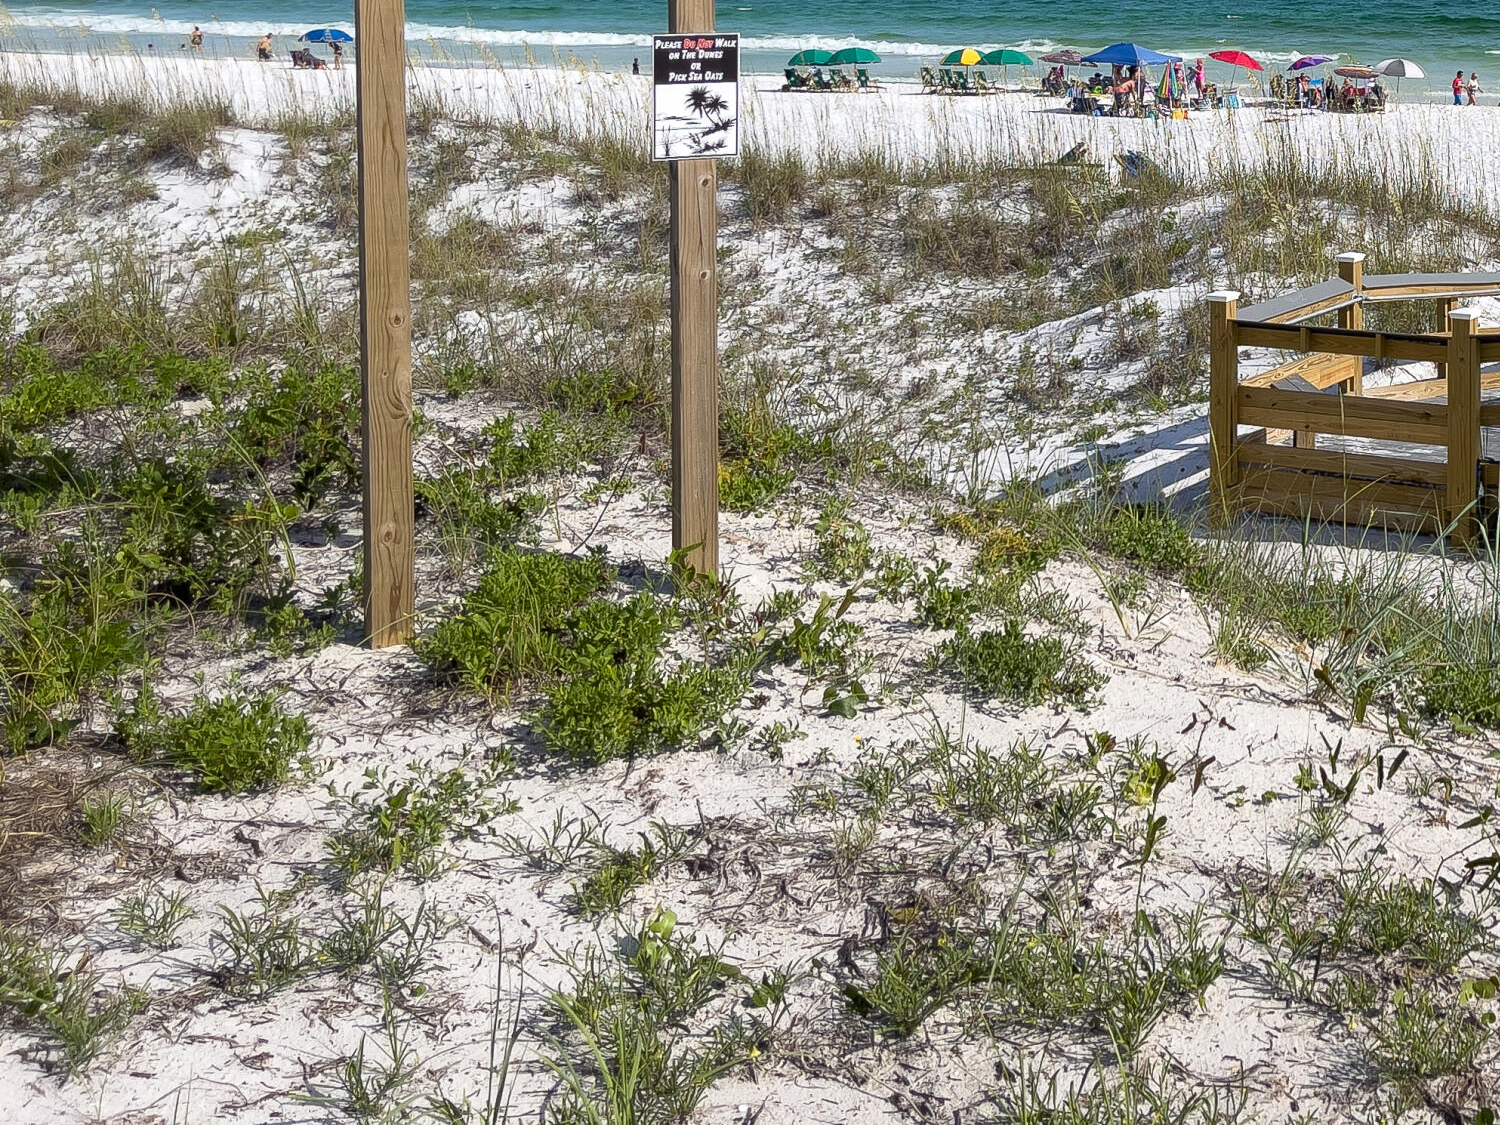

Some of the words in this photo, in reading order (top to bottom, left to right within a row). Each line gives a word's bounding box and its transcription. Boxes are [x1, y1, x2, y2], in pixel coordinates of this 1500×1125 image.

[655, 40, 682, 49] PLEASE
[715, 38, 736, 47] WALK
[669, 72, 687, 81] PICK
[688, 71, 703, 81] SEA
[705, 71, 723, 80] OATS
